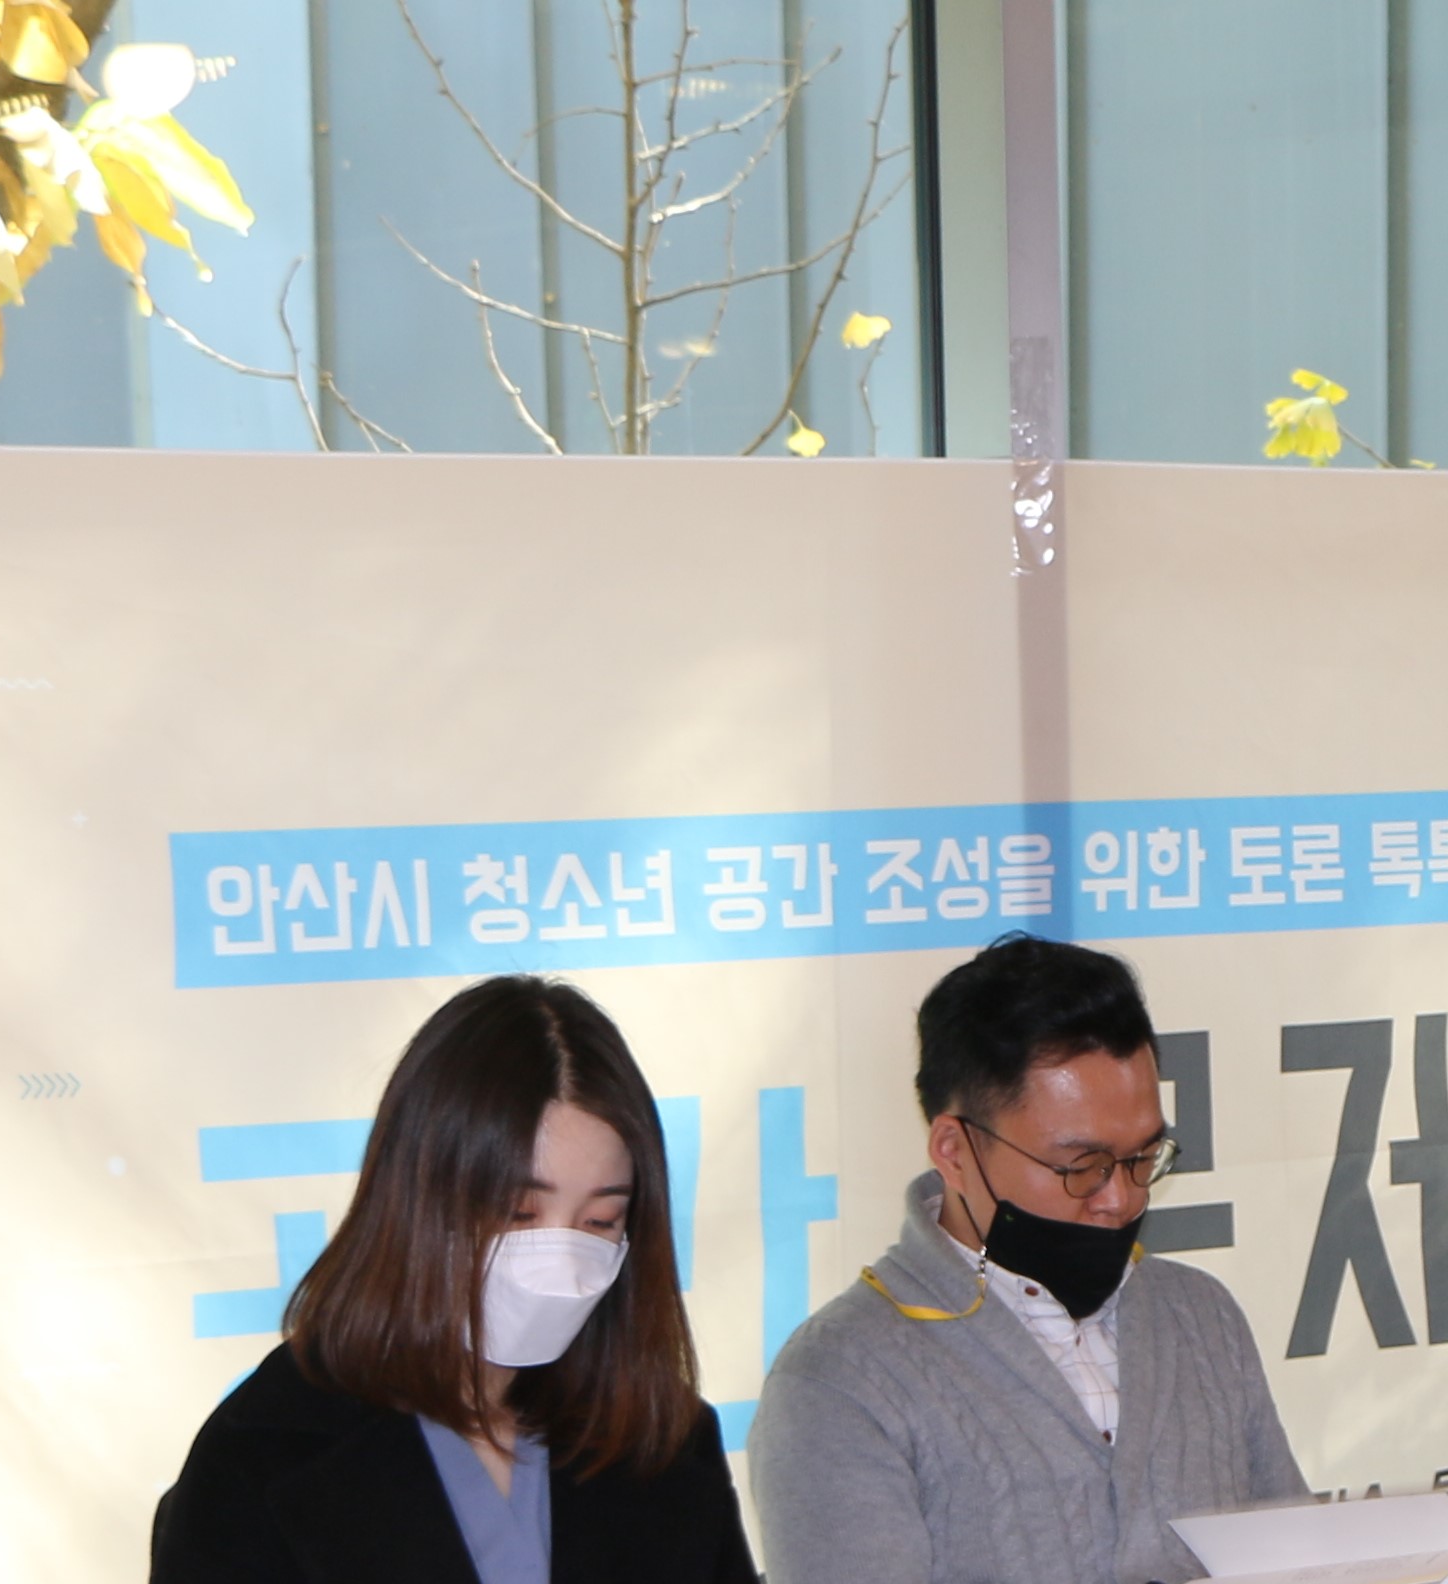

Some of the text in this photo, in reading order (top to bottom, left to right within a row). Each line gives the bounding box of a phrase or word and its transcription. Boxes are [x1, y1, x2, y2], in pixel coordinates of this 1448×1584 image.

[206, 858, 432, 956] 안산시
[462, 848, 677, 945] 청소년
[702, 842, 839, 933] 공간
[864, 832, 1055, 924] 조성을
[1080, 826, 1206, 912] 위한
[1228, 823, 1346, 906] 토론
